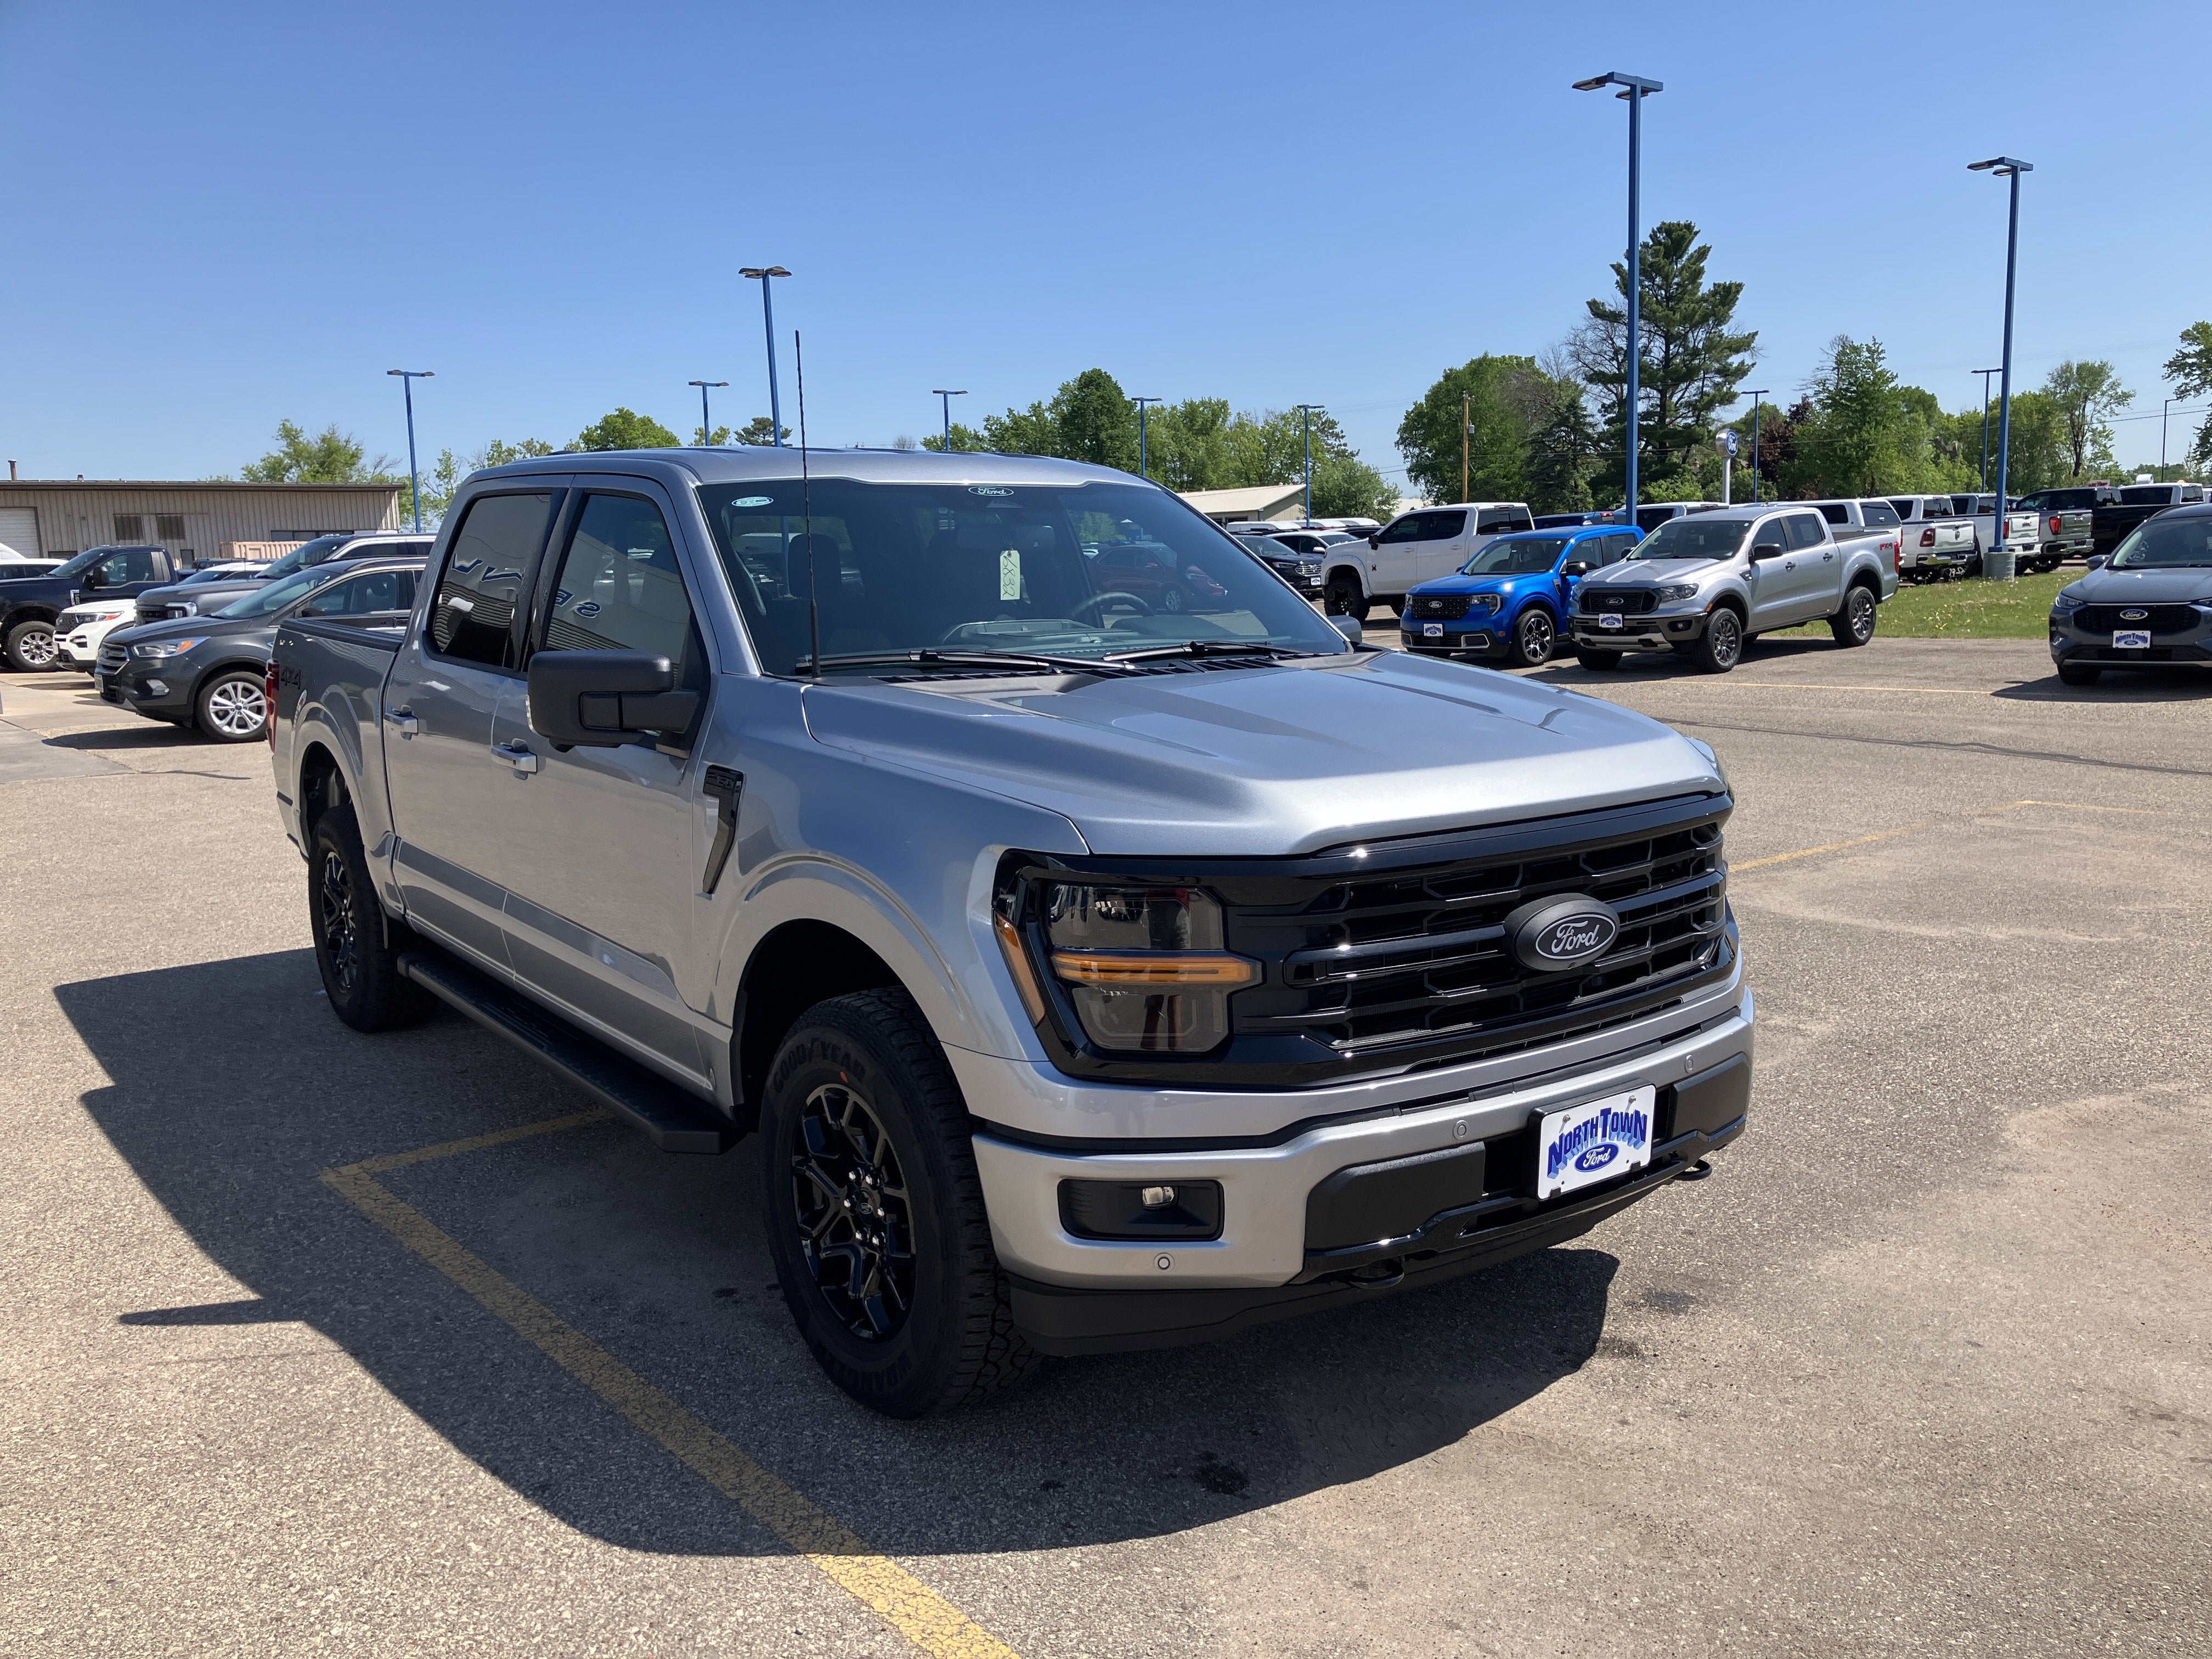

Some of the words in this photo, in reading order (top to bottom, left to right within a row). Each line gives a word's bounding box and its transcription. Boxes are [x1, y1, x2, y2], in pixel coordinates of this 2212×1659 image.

[1002, 556, 1017, 600] 6832
[1551, 921, 1600, 953] Ford
[1583, 1147, 1611, 1167] Ford
